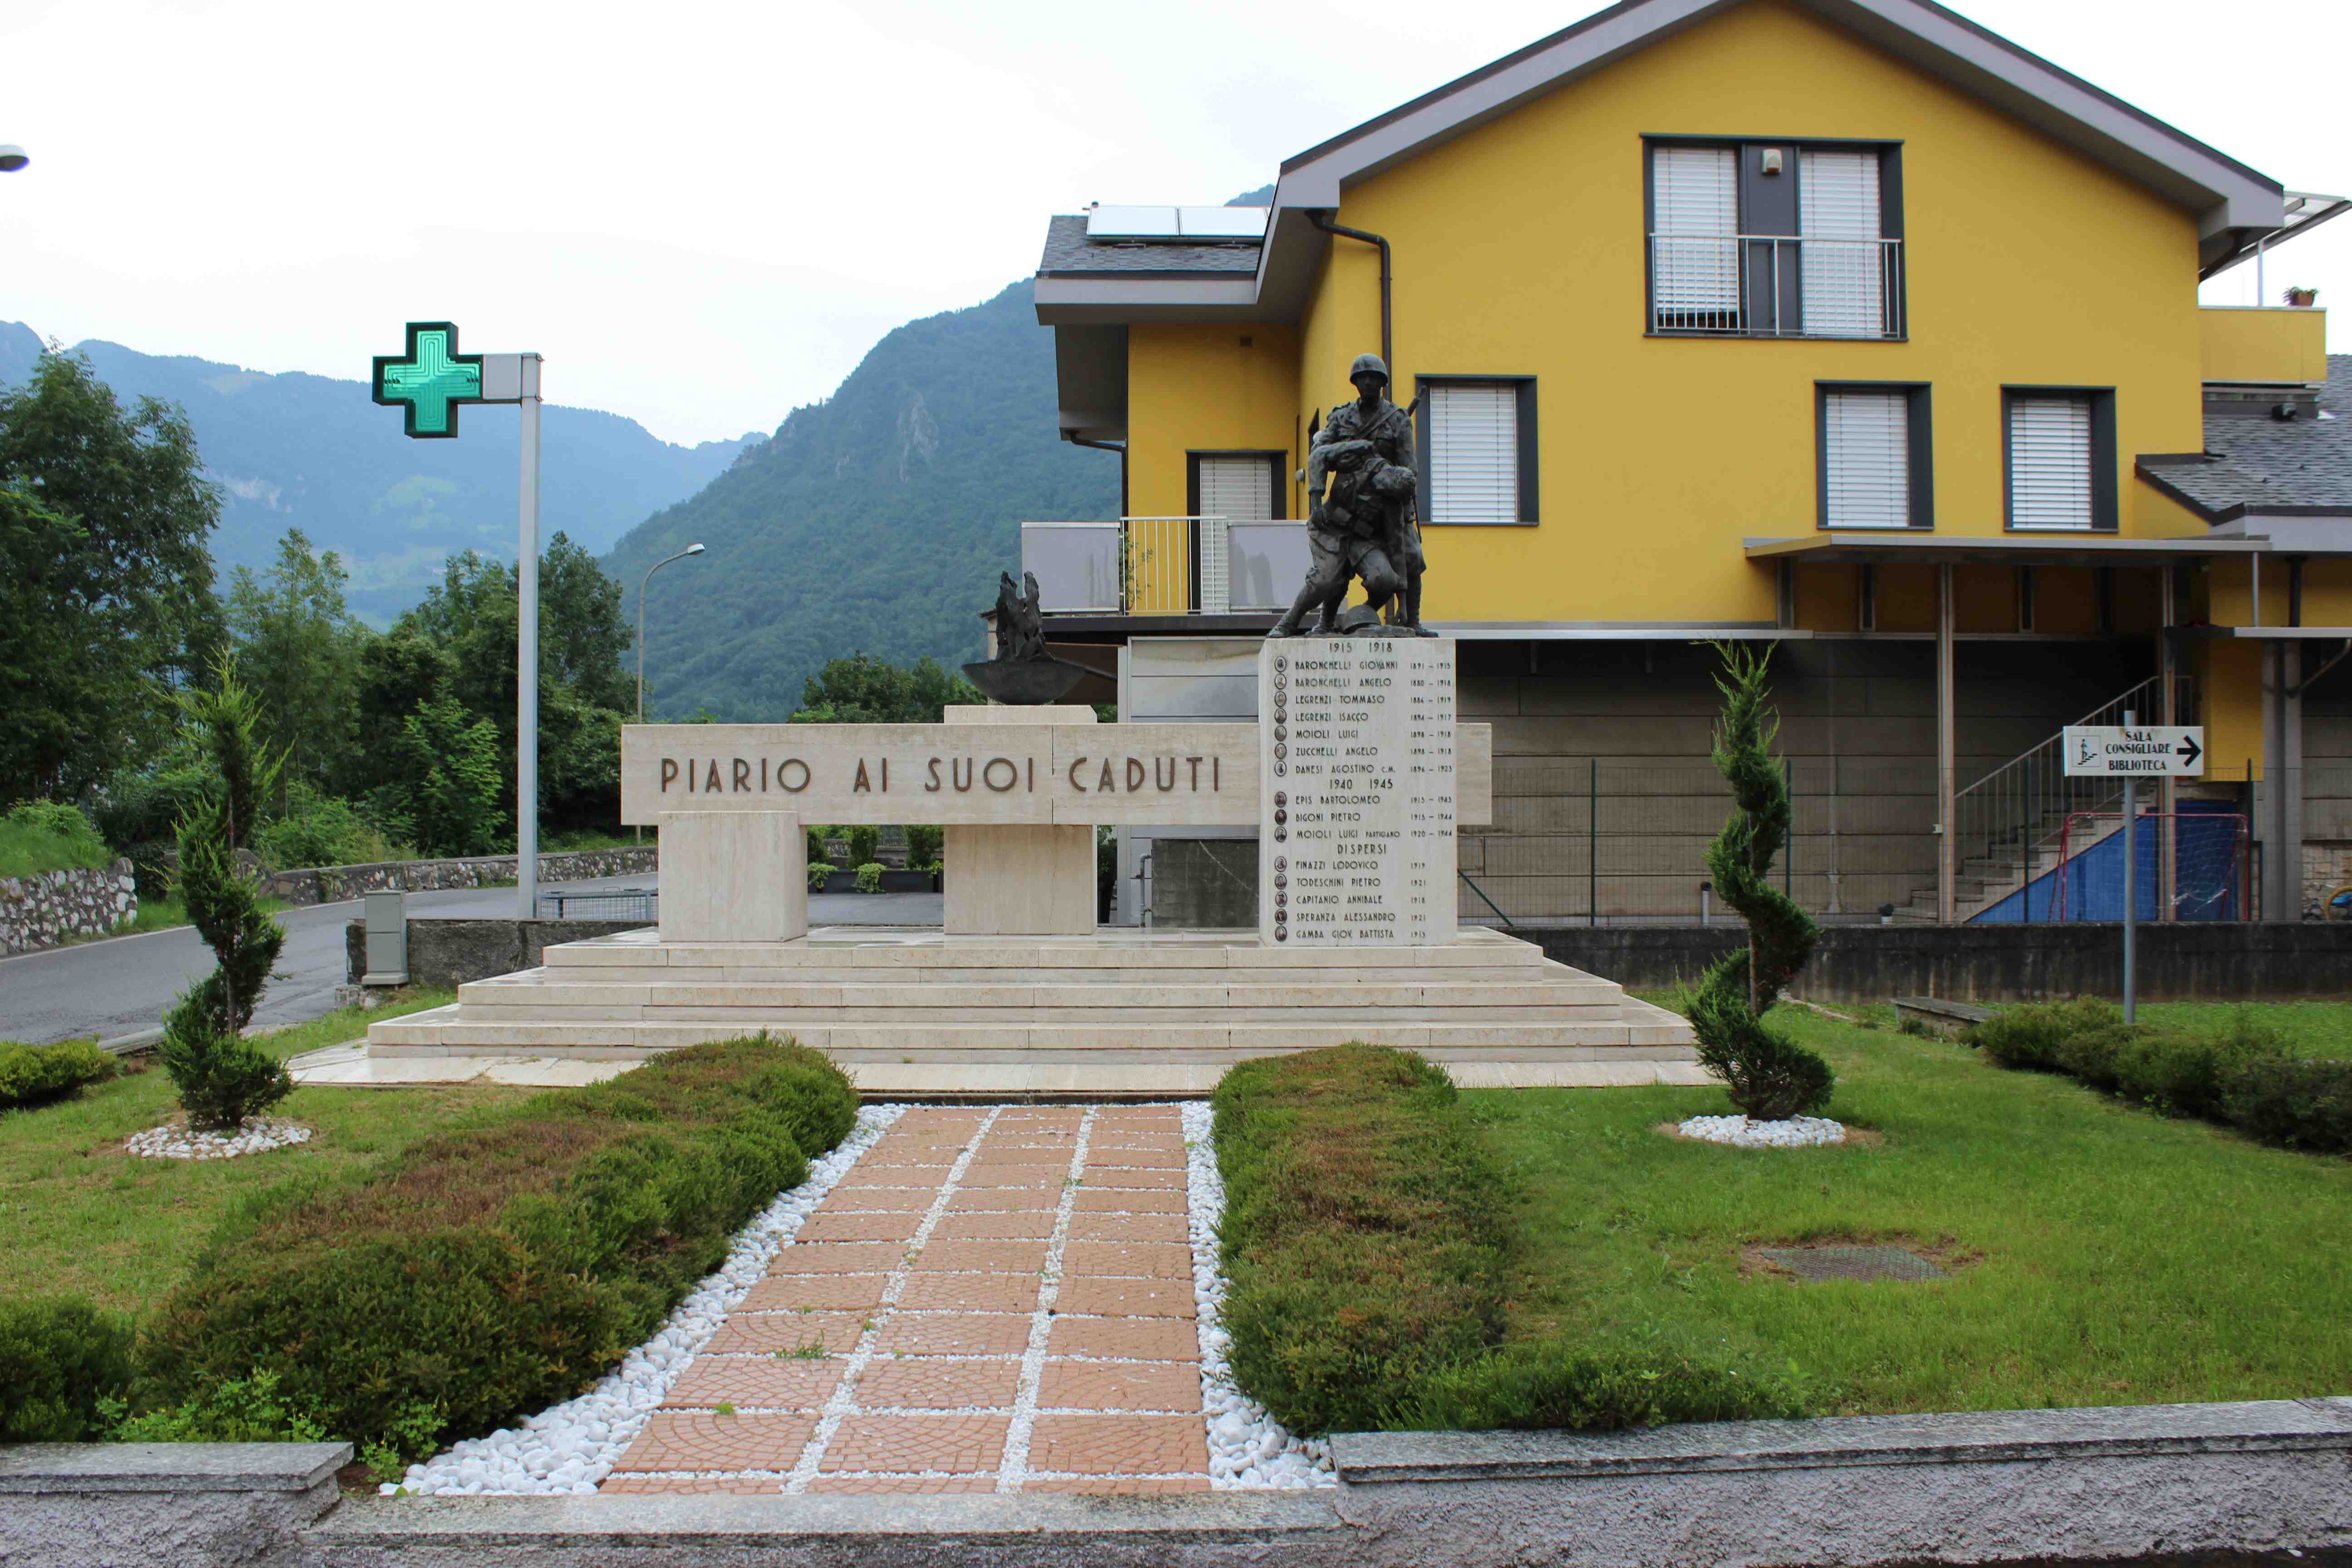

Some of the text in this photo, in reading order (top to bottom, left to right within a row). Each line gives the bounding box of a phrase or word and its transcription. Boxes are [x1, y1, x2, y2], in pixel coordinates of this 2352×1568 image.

[1329, 642, 1392, 653] 1915 1918
[1295, 661, 1351, 670] BARONCHELLI
[1359, 661, 1398, 670] GIOVANNI
[1295, 678, 1350, 687] BARONCHELLI
[1359, 678, 1392, 686] ANGELO
[1295, 695, 1332, 704] LEGRENZI
[1339, 695, 1385, 704] TOMMASO
[1295, 713, 1331, 721] LEGRENZI
[1339, 712, 1368, 721] ISACCO
[1296, 730, 1330, 739] MOIOLI
[1338, 730, 1358, 739] LUIGI
[2125, 731, 2152, 742] SALA
[1296, 747, 1338, 756] ZUCCHELLI
[1345, 747, 1378, 756] ANGELO
[2105, 743, 2171, 754] CONSIGLIARE
[1295, 765, 1323, 774] DANESI
[1331, 764, 1374, 774] AGOSTINO
[2108, 760, 2166, 771] BIBLIOTECA
[661, 756, 1219, 793] PIARIO AI SUOI CADUTI
[1330, 779, 1393, 789] 1940 1945
[1295, 795, 1313, 804] EPIS
[1320, 795, 1380, 804] BARTOLOMEO
[1295, 813, 1323, 822] BIGONI
[1331, 813, 1361, 822] PIETRO
[1296, 830, 1332, 839] MOIOLI
[1338, 829, 1358, 838] LUIGI
[1337, 843, 1387, 855] DISPERSI
[1295, 861, 1326, 870] FINAZZI
[1333, 861, 1379, 870] LODOVICO
[1296, 878, 1344, 887] TODESCHINI
[1351, 877, 1381, 887] PIETRO
[1296, 895, 1339, 904] CAPITANIO
[1347, 895, 1383, 904] ANNIBALE
[1296, 912, 1336, 922] SPERANZA
[1344, 912, 1396, 921] ALESSANDRO
[1296, 930, 1324, 939] GAMBA
[1360, 929, 1394, 938] BATTISTA
